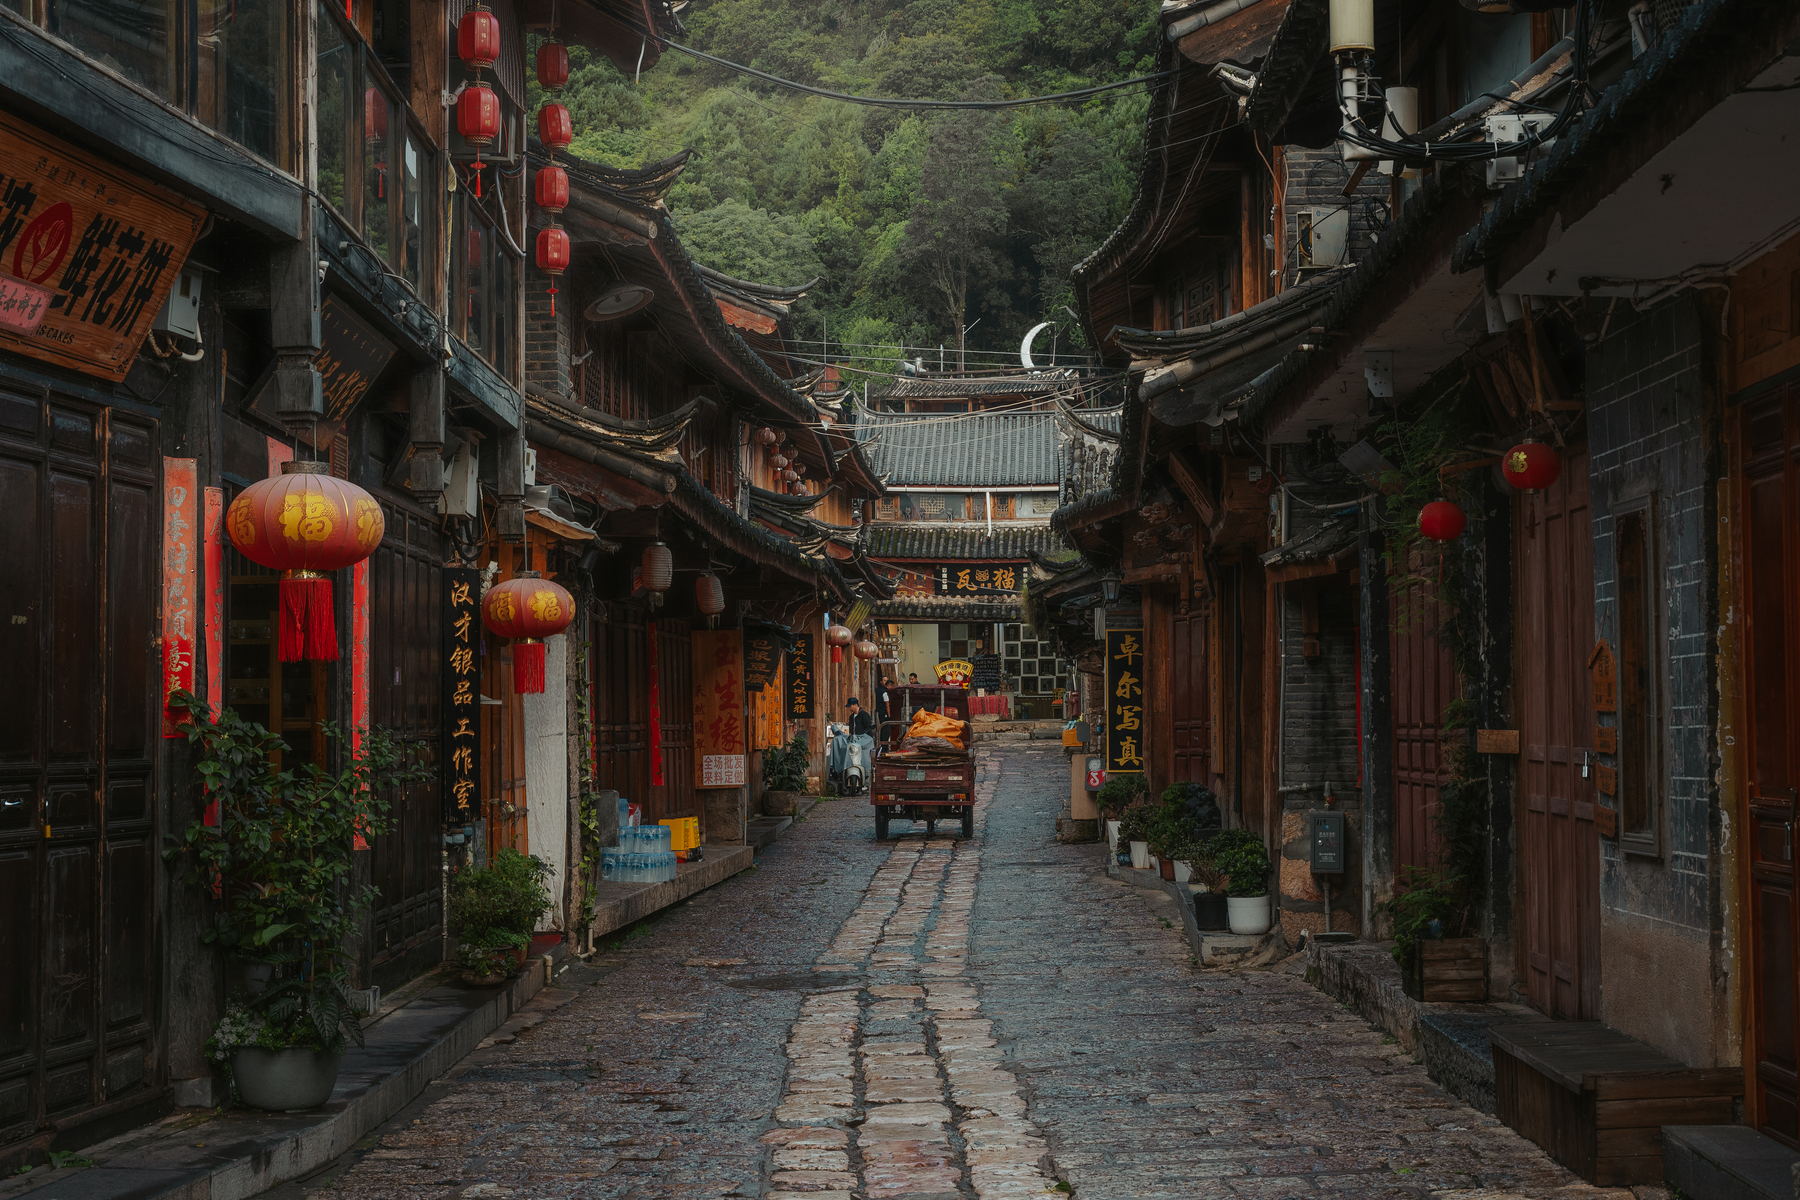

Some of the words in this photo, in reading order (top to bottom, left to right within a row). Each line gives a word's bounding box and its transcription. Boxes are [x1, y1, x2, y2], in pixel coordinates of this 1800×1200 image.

[278, 494, 334, 542] 福
[527, 591, 561, 622] 福
[450, 579, 477, 810] 汉才银品工作室
[1113, 633, 1144, 767] 卓尔写真
[704, 756, 744, 770] 全场批发
